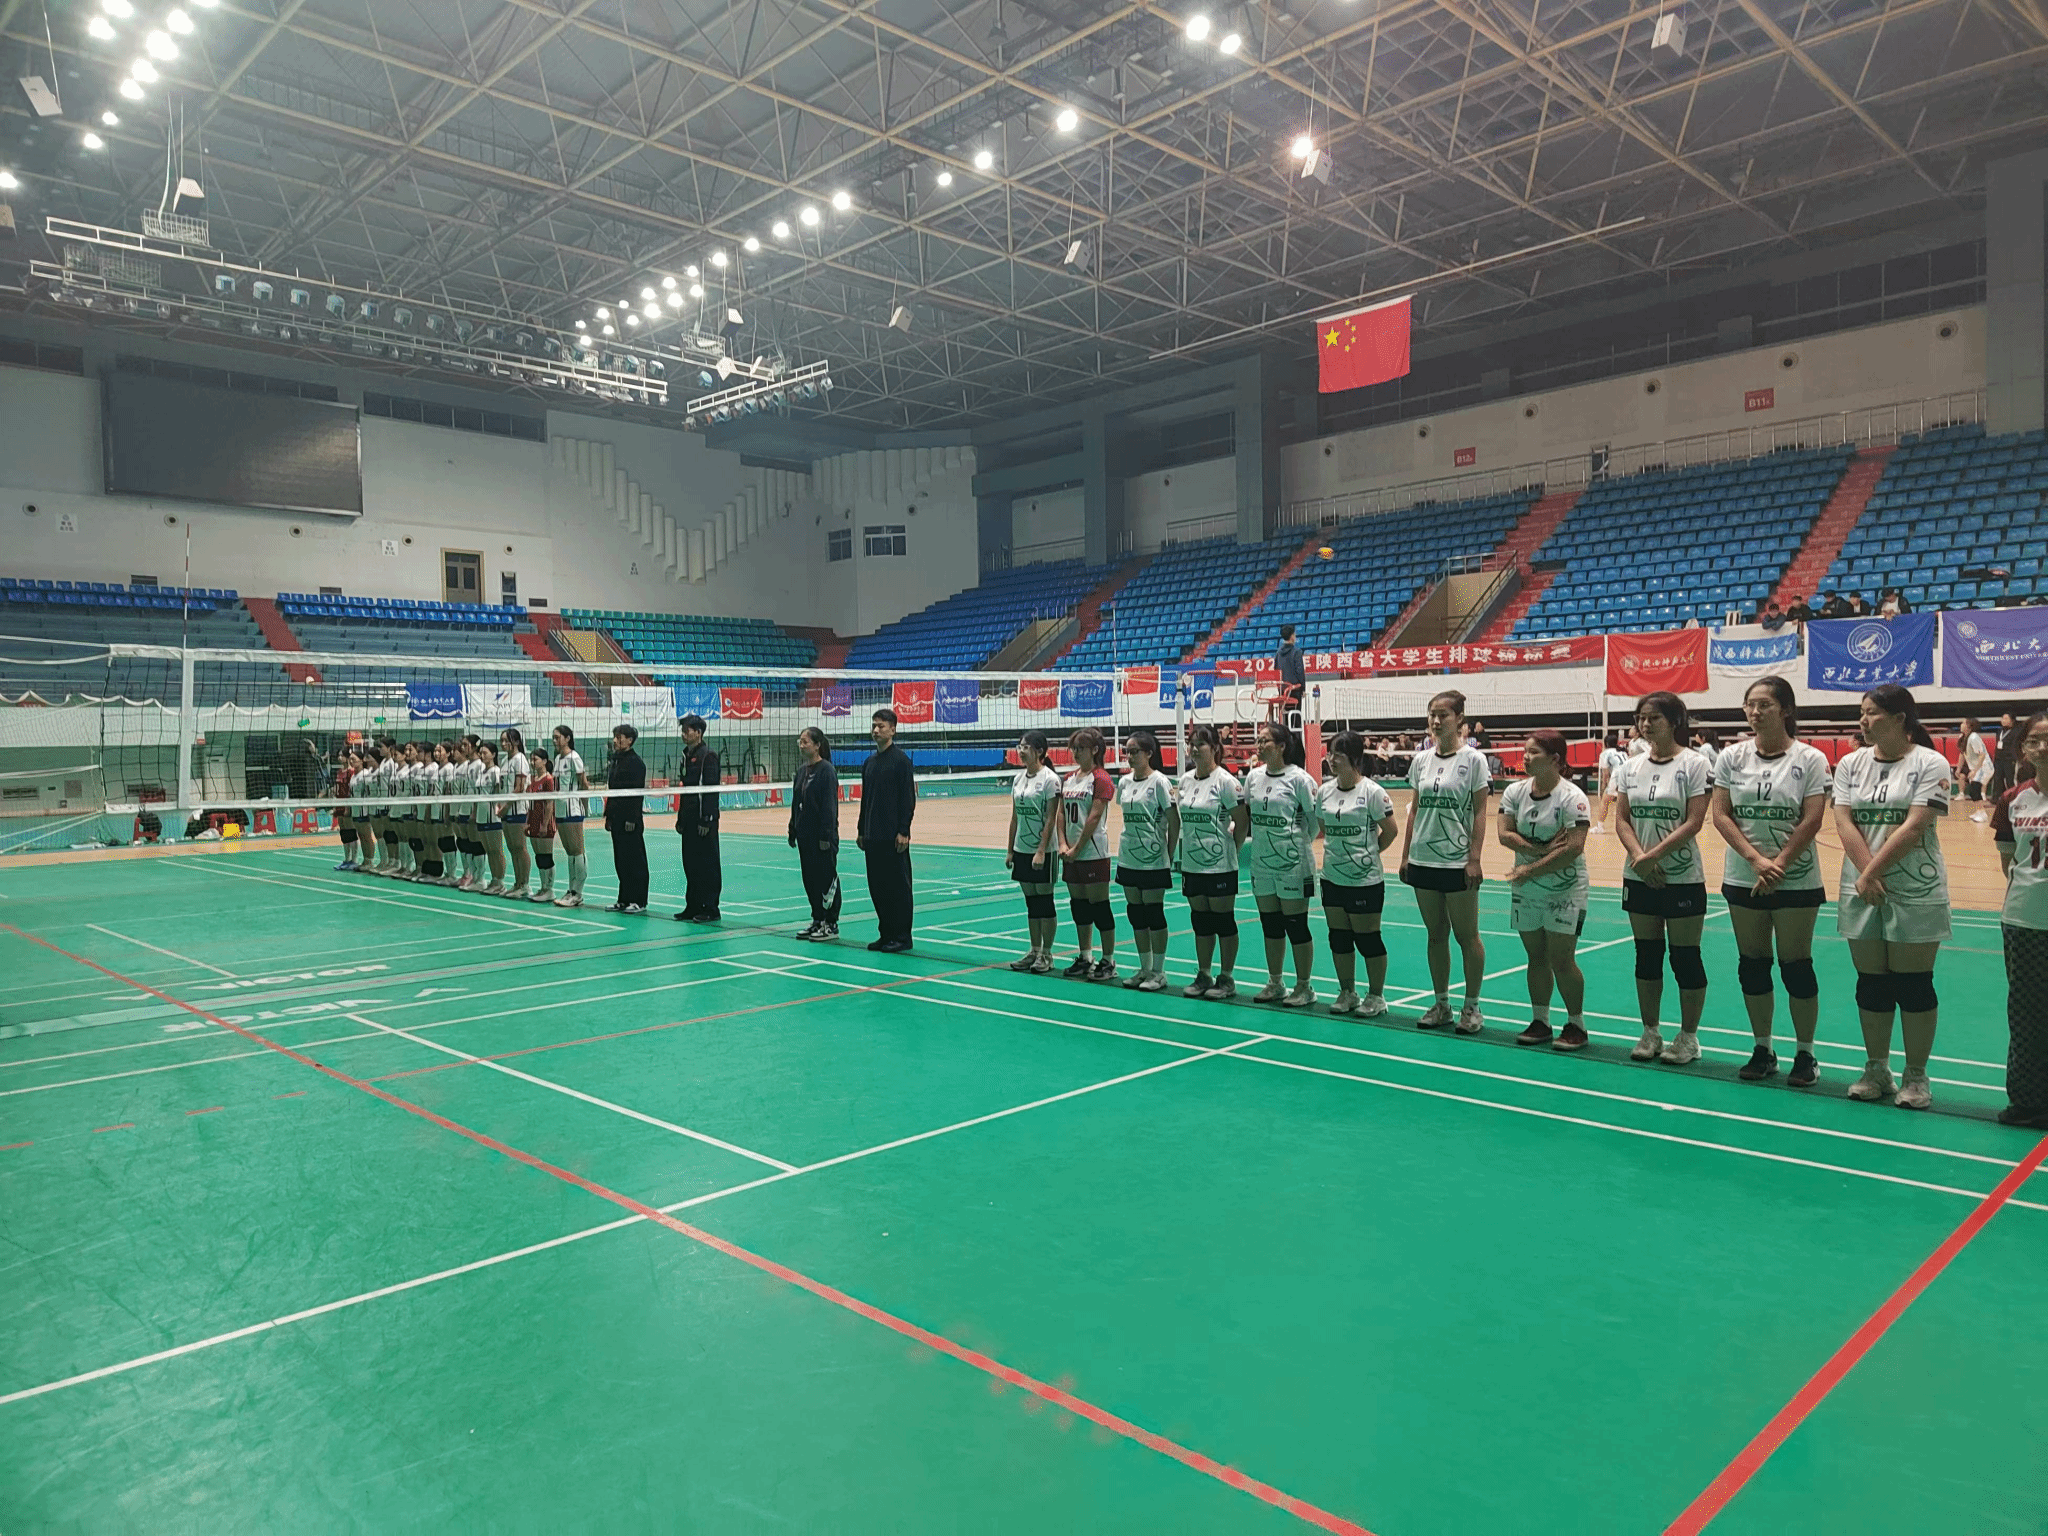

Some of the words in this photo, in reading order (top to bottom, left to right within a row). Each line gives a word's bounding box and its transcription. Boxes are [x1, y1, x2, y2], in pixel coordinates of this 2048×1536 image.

[1433, 778, 1440, 792] 6
[1649, 785, 1656, 801] 8
[1757, 782, 1772, 801] 12
[1871, 785, 1888, 803] 18
[1066, 802, 1078, 823] 10
[1263, 797, 1268, 811] 3
[1335, 809, 1340, 822] 4
[1529, 822, 1536, 837] 7
[187, 964, 391, 990] VICTOR
[158, 999, 393, 1033] VICTOR
